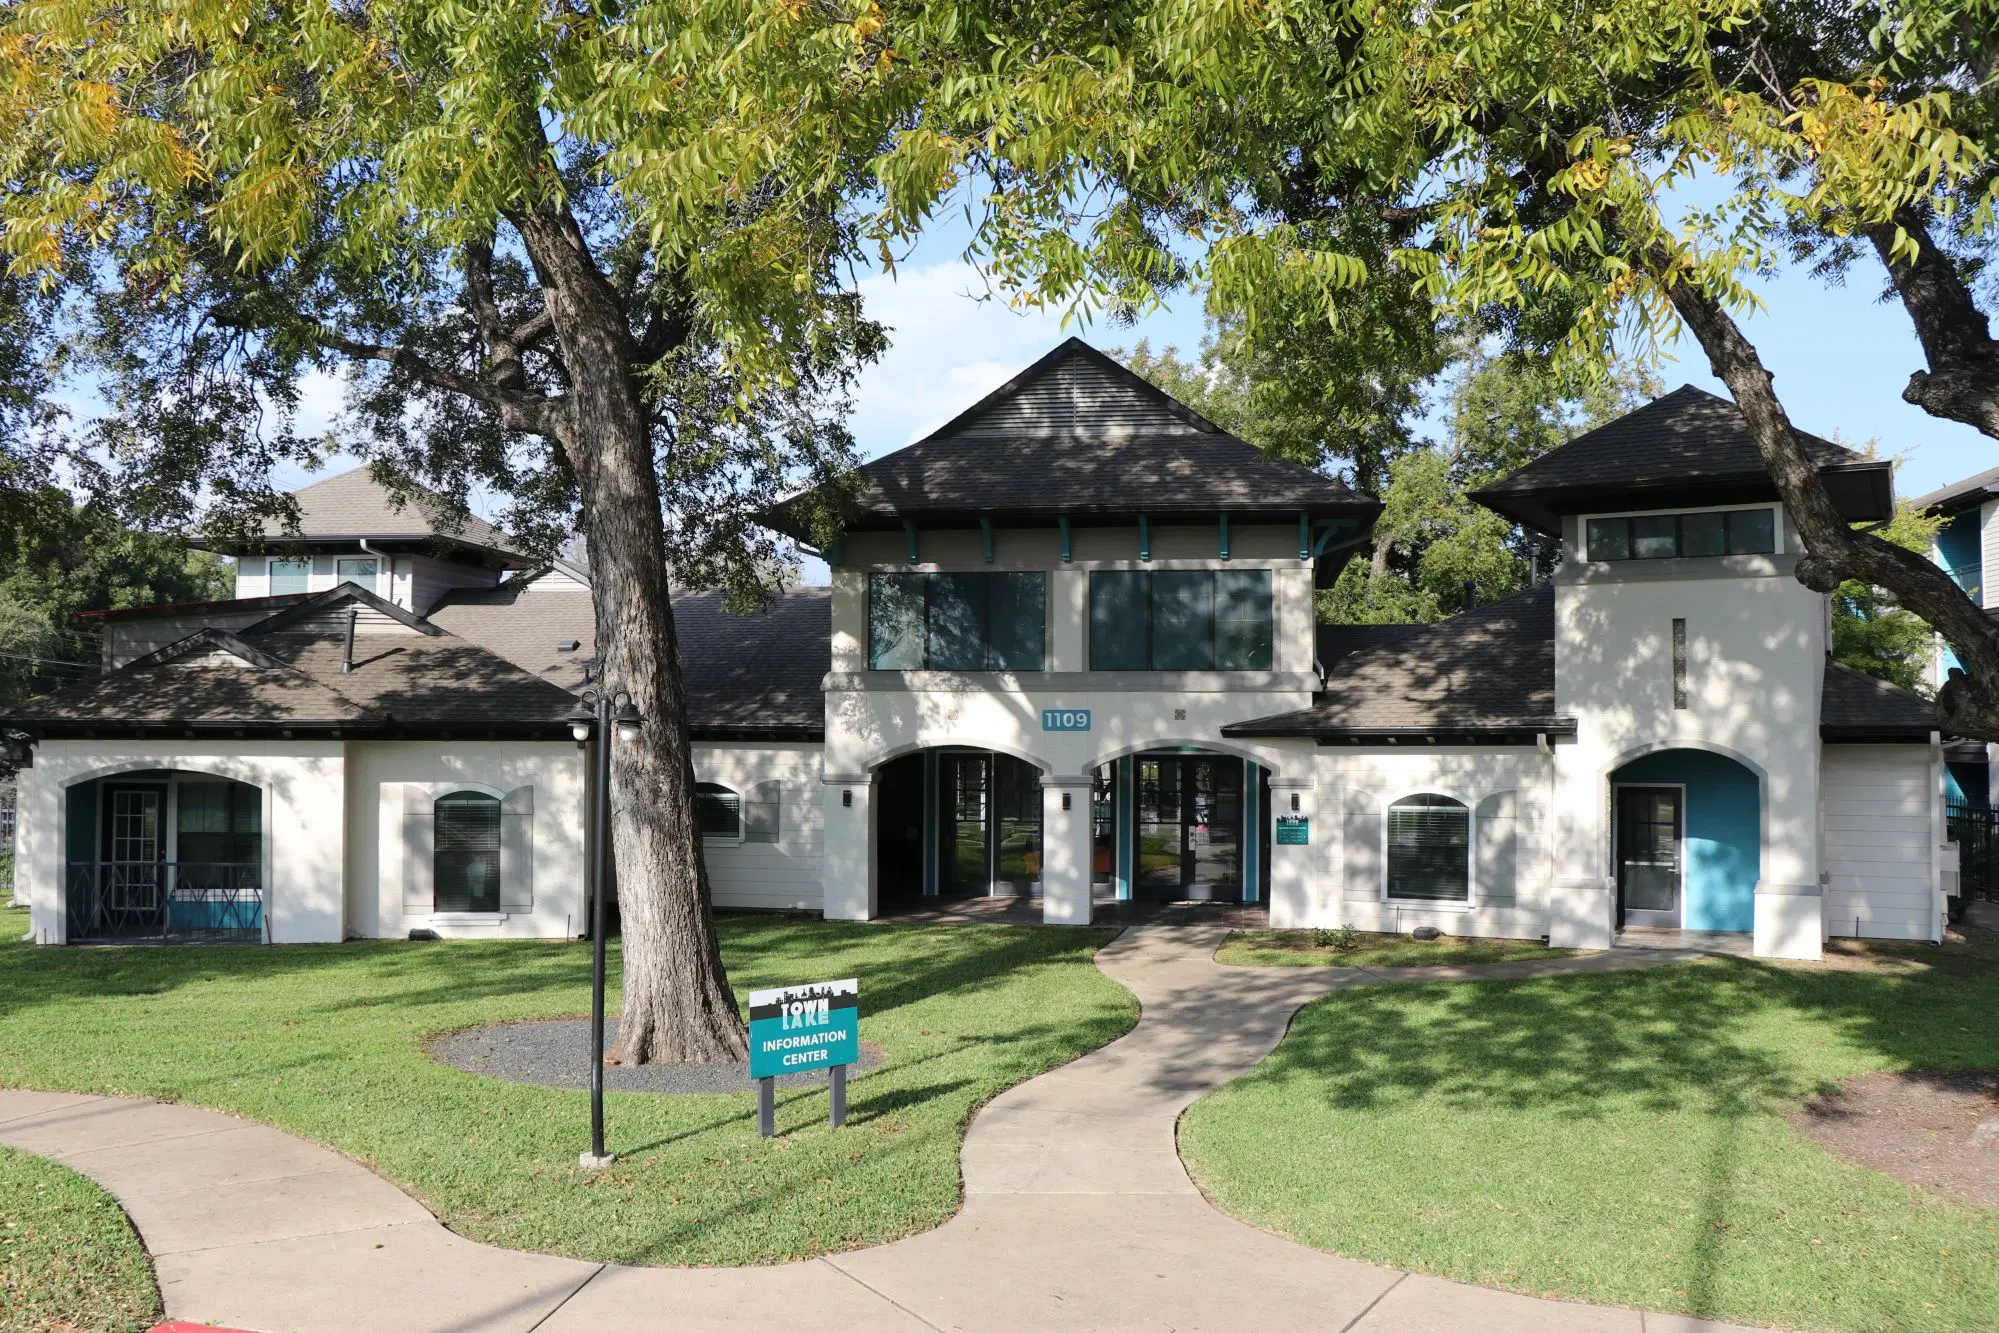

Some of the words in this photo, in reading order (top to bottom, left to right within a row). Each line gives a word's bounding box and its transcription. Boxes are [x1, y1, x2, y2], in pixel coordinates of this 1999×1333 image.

[1045, 712, 1088, 728] 1109
[781, 998, 829, 1016] TOWN
[782, 1010, 829, 1030] LAKE
[763, 1029, 847, 1052] INFORMATION
[782, 1049, 828, 1066] CENTER
